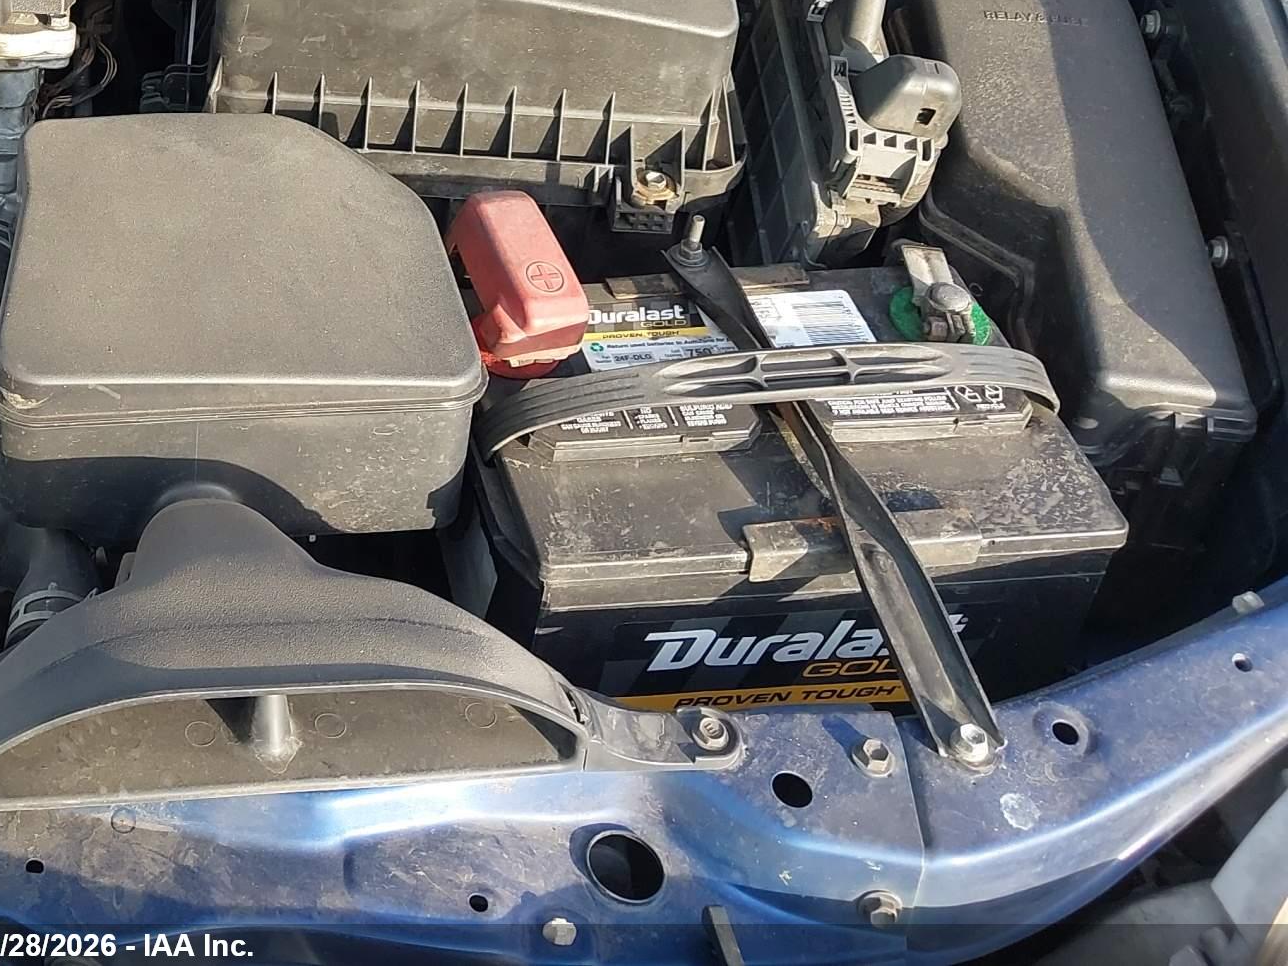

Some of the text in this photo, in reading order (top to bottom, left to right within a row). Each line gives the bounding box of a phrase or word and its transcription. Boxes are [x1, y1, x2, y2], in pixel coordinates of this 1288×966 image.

[983, 10, 1032, 22] RELAY
[640, 319, 688, 328] GOLD
[801, 658, 897, 678] GOL
[674, 685, 896, 710] PROVEN TOUGH
